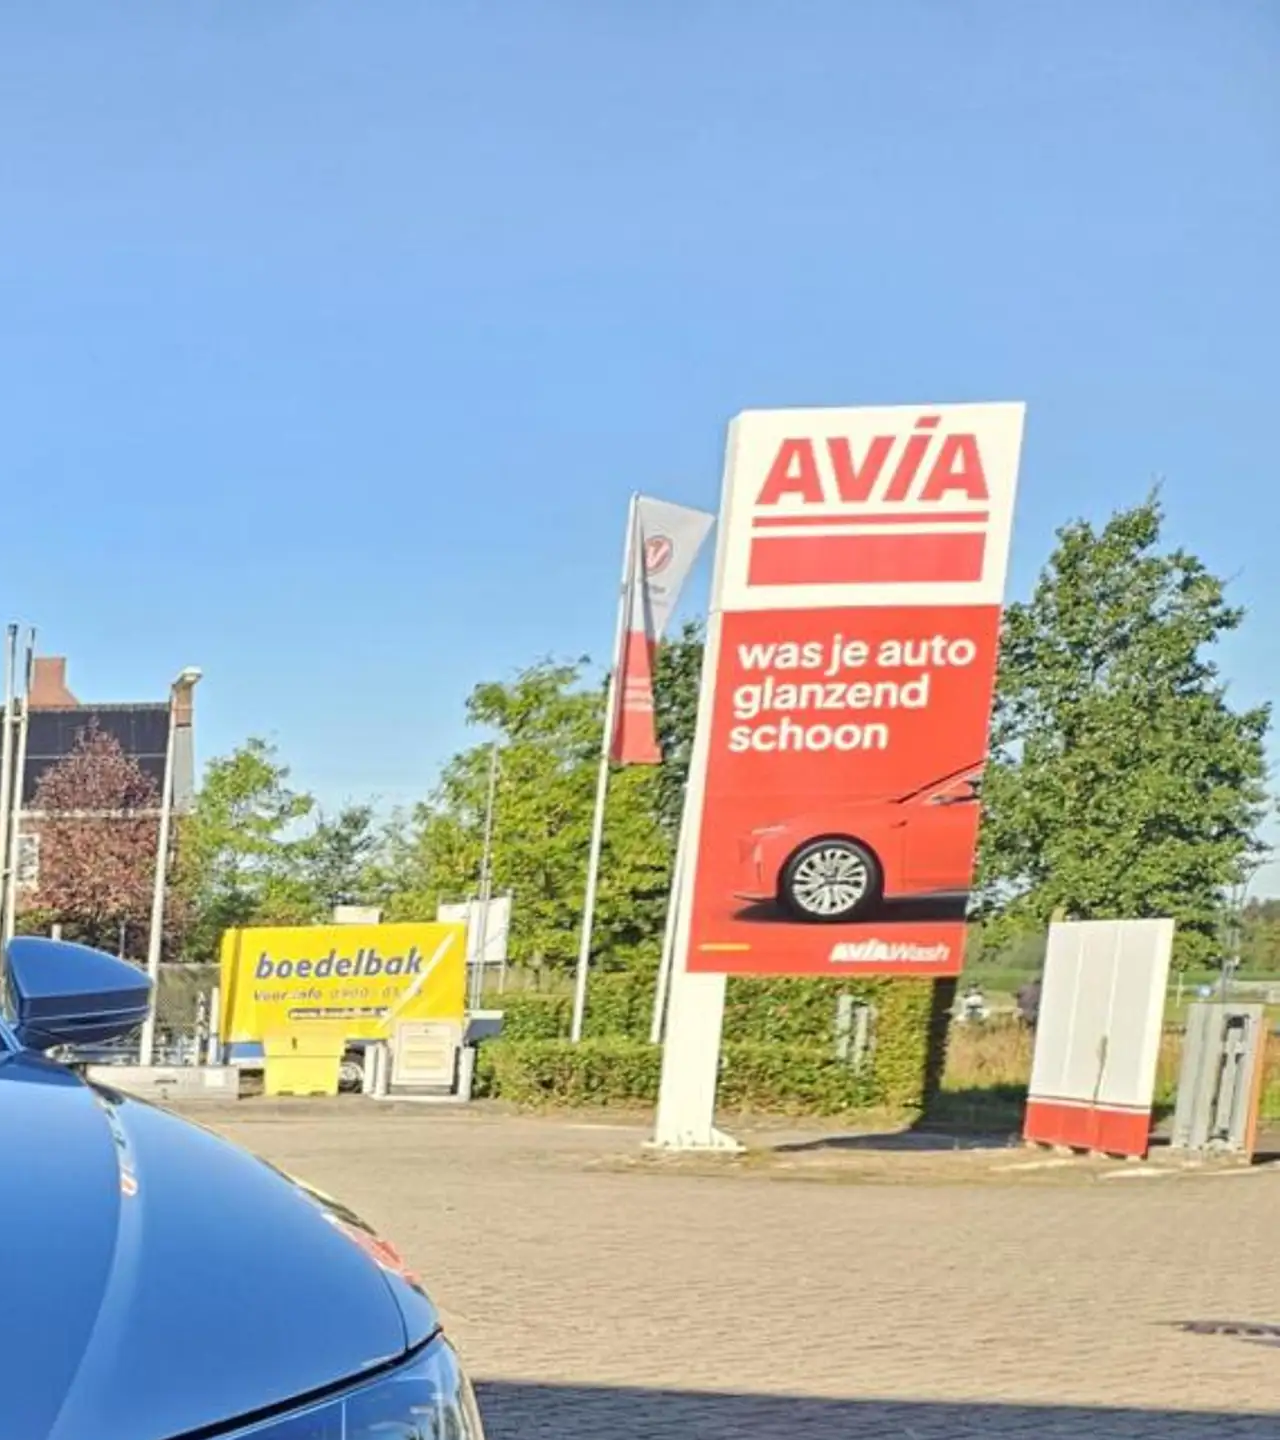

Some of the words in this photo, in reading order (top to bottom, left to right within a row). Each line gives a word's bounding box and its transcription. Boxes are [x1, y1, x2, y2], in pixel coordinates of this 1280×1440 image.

[755, 415, 990, 505] AVIA
[737, 641, 823, 670] was
[824, 633, 869, 676] je
[876, 634, 977, 667] auto
[732, 672, 931, 720] glanzend
[728, 716, 889, 752] schoon
[254, 946, 424, 980] boedelbak
